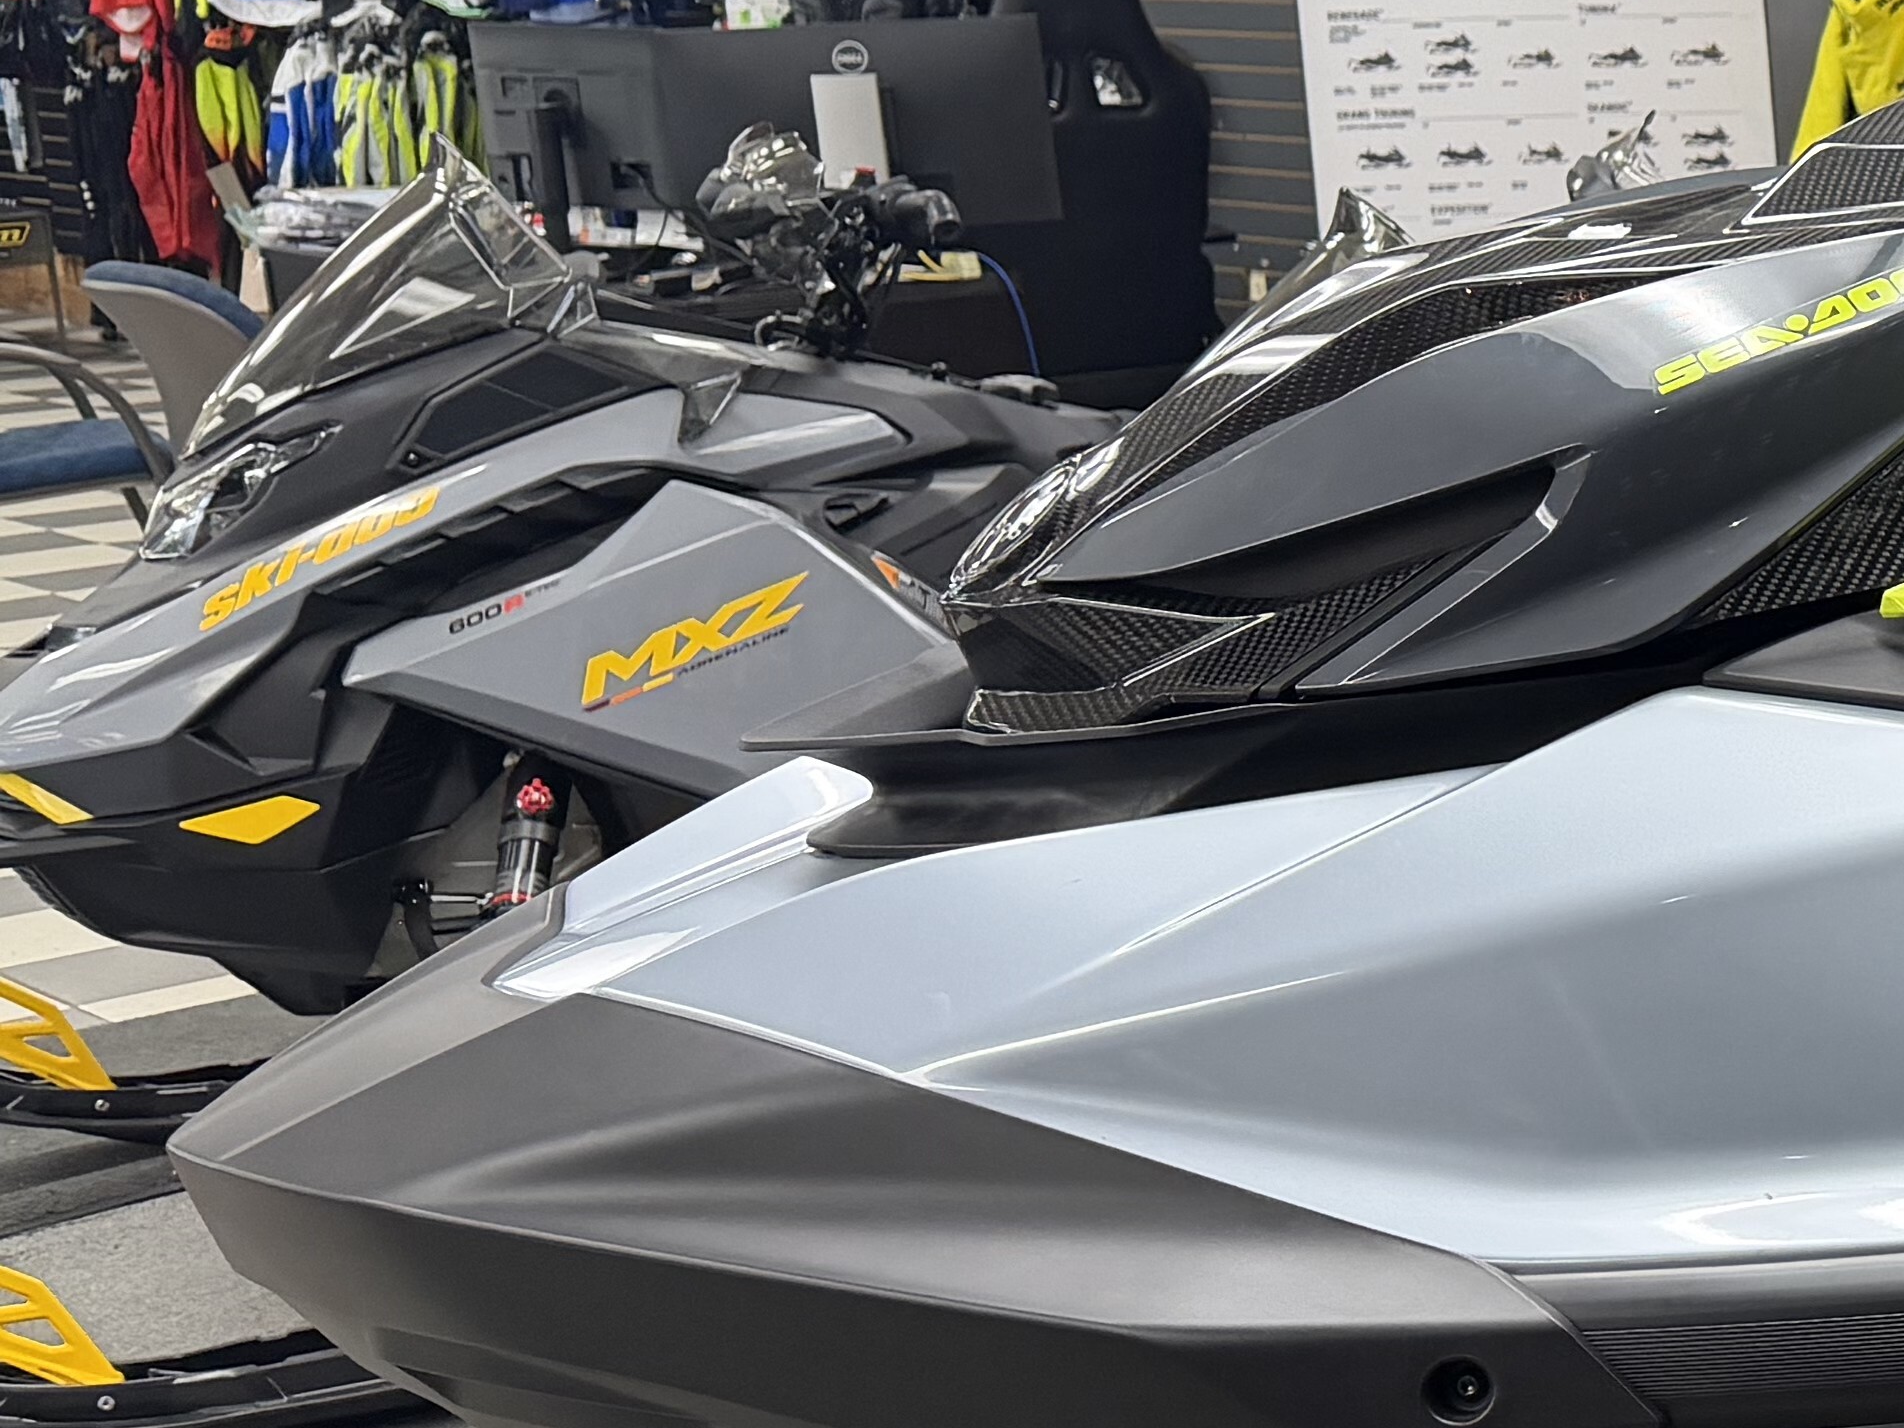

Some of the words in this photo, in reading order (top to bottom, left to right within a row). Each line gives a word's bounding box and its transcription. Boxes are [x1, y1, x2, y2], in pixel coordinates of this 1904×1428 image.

[199, 486, 440, 632] ski-doo
[581, 571, 809, 706] MXZ
[677, 626, 790, 677] ADRENALINE
